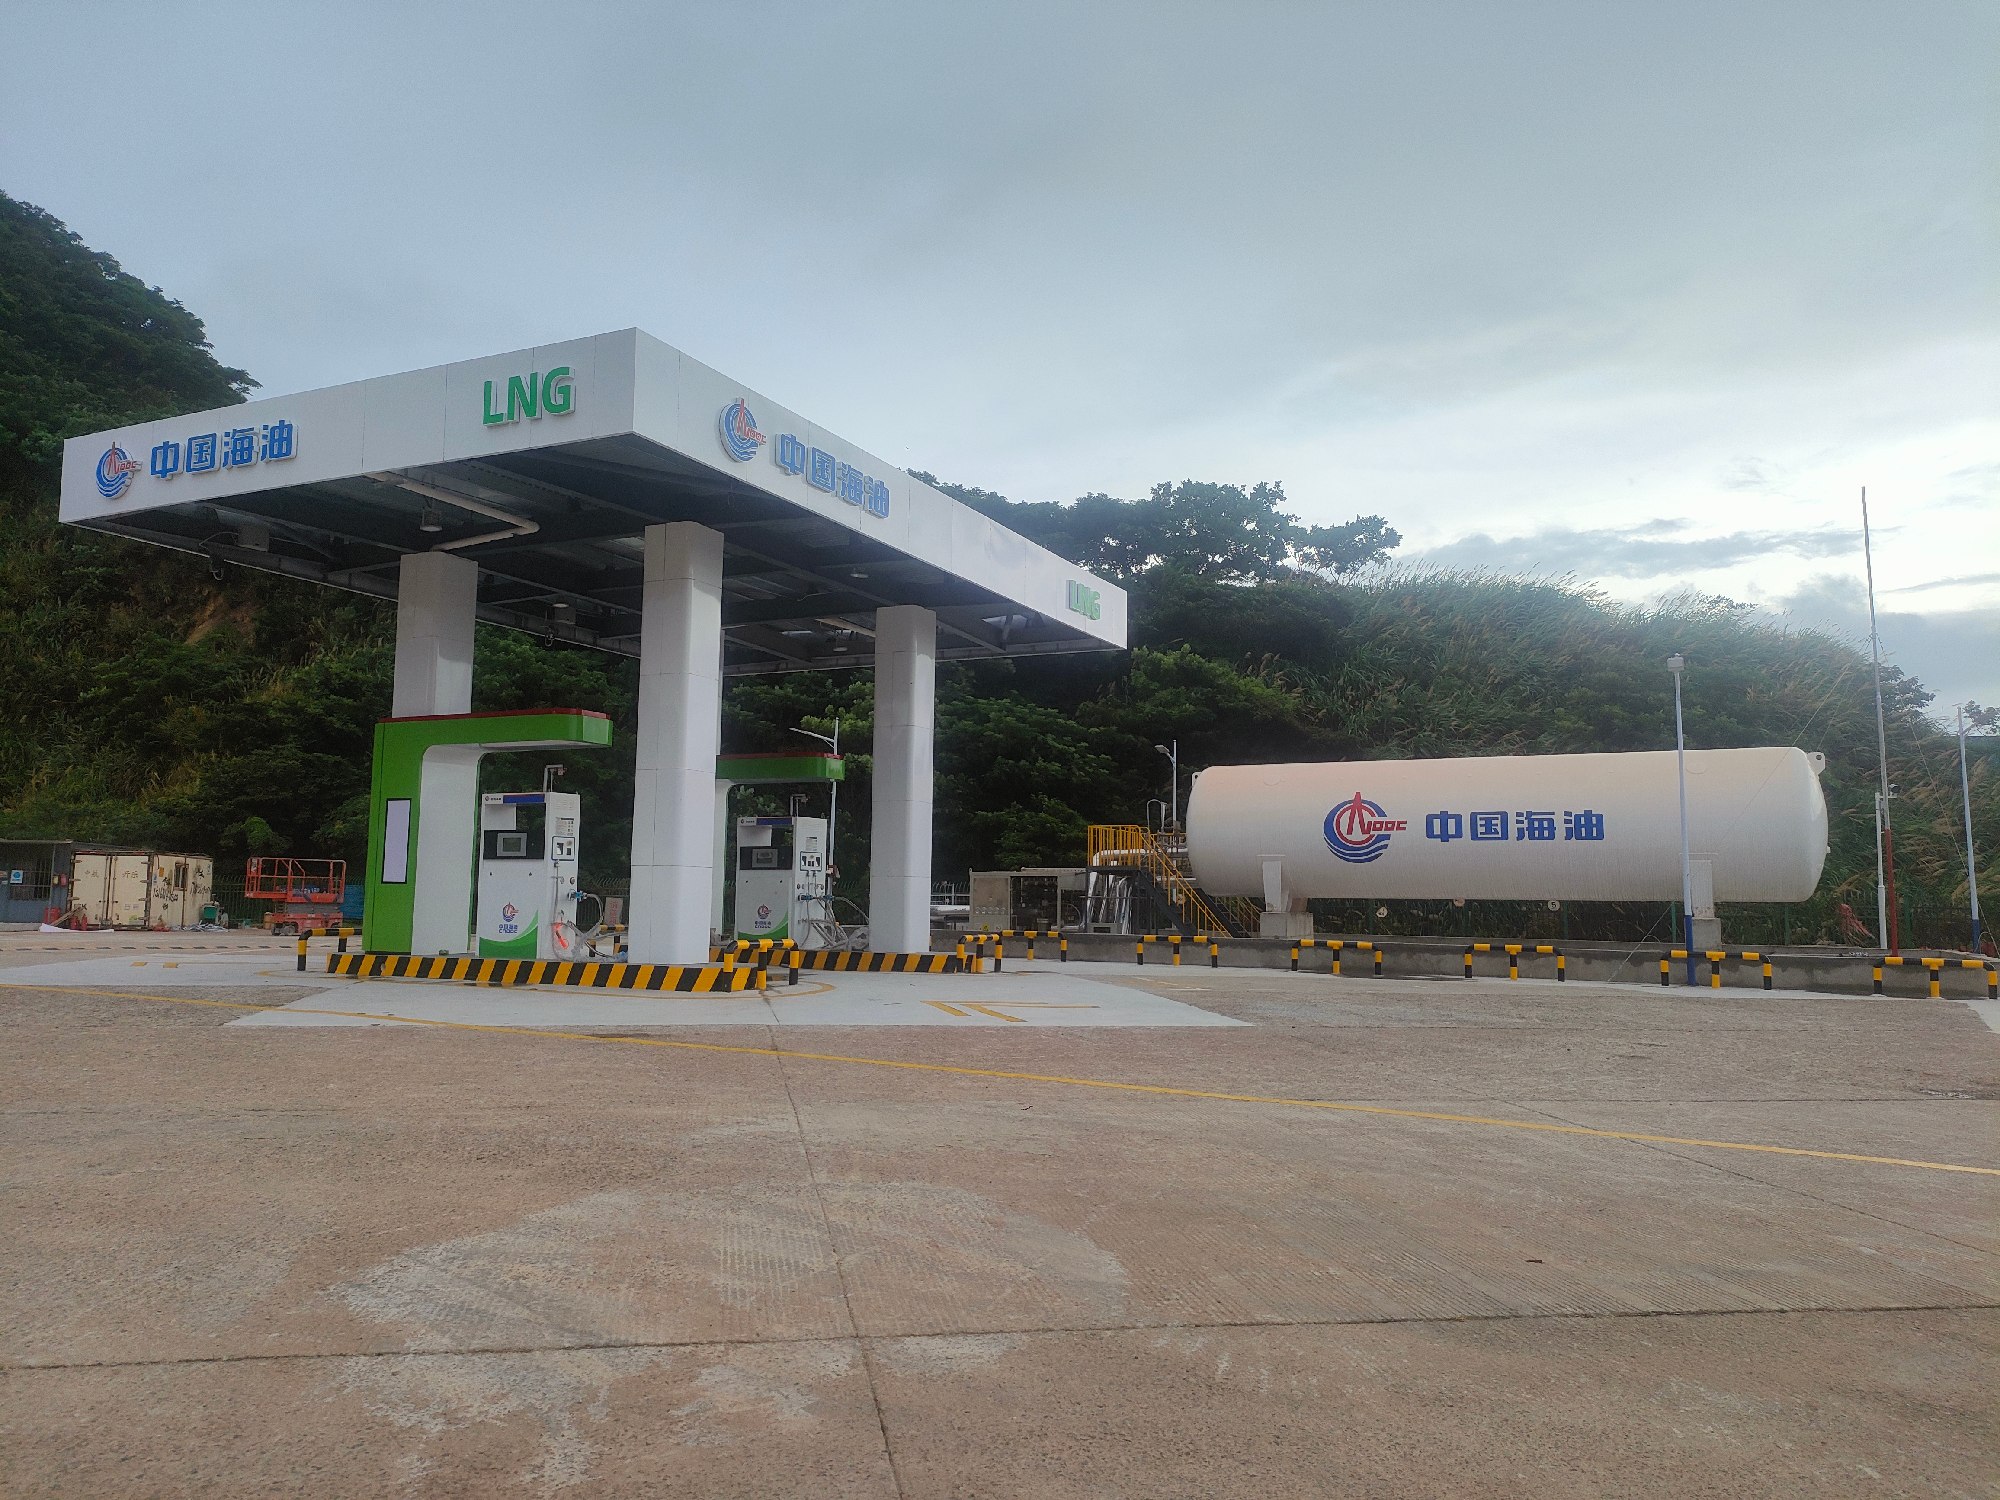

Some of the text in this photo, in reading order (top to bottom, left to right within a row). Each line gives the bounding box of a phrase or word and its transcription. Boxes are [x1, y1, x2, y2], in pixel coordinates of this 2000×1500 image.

[482, 366, 573, 425] LNG
[150, 419, 295, 479] 中国海油
[778, 433, 890, 519] 中国海油
[1068, 580, 1101, 621] LNG
[1425, 809, 1606, 843] 中国海油
